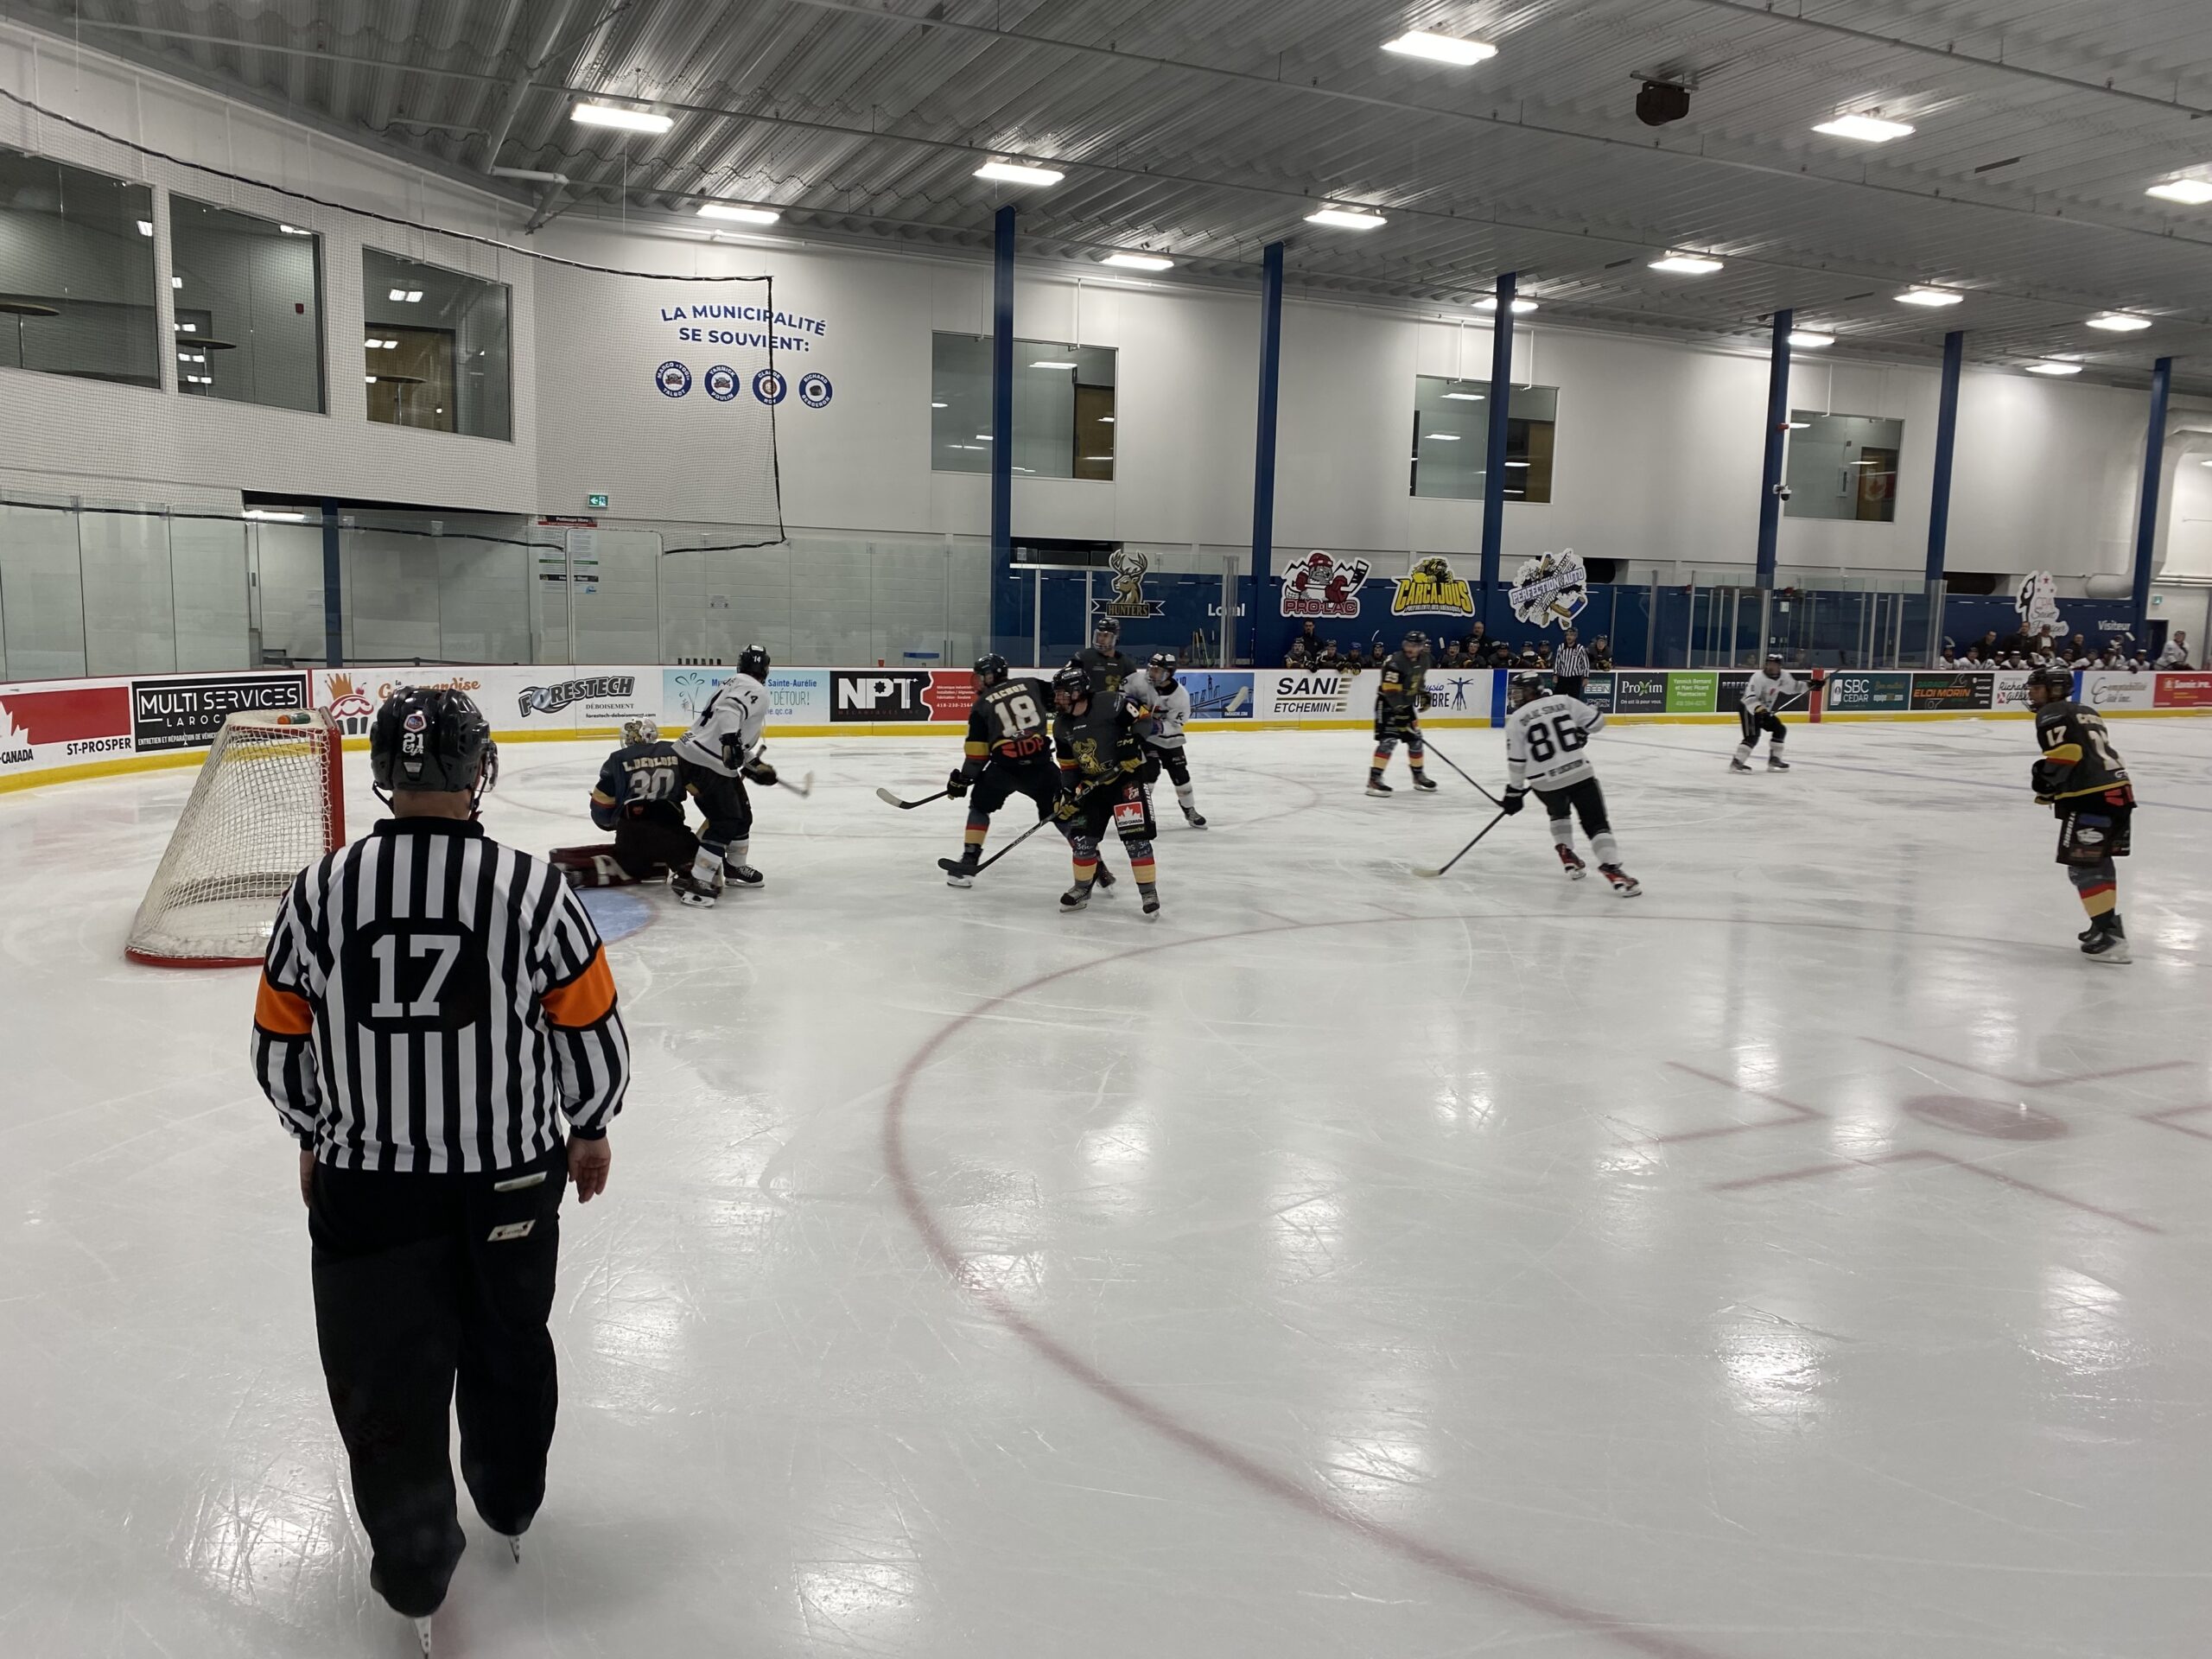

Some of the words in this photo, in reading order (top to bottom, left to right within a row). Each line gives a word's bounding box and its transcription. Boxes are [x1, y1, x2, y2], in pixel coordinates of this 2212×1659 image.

[661, 307, 687, 321] LA
[692, 305, 827, 336] MUNICIPALITÉ
[679, 327, 702, 342] SE
[709, 329, 810, 352] SOUVIENT:
[657, 362, 674, 379] MARCO
[709, 365, 736, 378] YANNICK
[803, 373, 828, 385] RICHARD
[663, 387, 686, 397] TALBOT
[711, 391, 734, 401] POULIN
[801, 394, 830, 408] BERGERON
[1511, 576, 1560, 605] PERFECTION
[1563, 568, 1585, 585] AUTO
[1394, 579, 1471, 613] CARCAJOUS
[1108, 605, 1148, 617] HUNTERS
[1207, 603, 1246, 617] Loal
[2097, 620, 2132, 631] Visiteur
[767, 678, 817, 688] Sainte-Aurélie
[1276, 677, 1338, 696] SANI
[1426, 683, 1445, 692] ysio
[1844, 679, 1870, 694] SBC
[518, 676, 635, 718] FORESTECH
[838, 677, 912, 709] NPT
[1843, 694, 1869, 702] CEDAR
[1913, 689, 1936, 697] ELOI
[1936, 689, 1971, 697] MORIN
[140, 692, 198, 715] MULTI
[203, 687, 298, 710] SERVICES
[1274, 702, 1332, 713] ETCHEMIN
[166, 714, 228, 728] LAROC
[995, 695, 1040, 737] 18
[137, 737, 162, 746] ENTRETIEN
[403, 733, 424, 749] 21
[1528, 714, 1583, 763] 86
[2046, 726, 2068, 747] 17
[67, 737, 132, 756] ST-PROSPER
[371, 934, 461, 1018] 17
